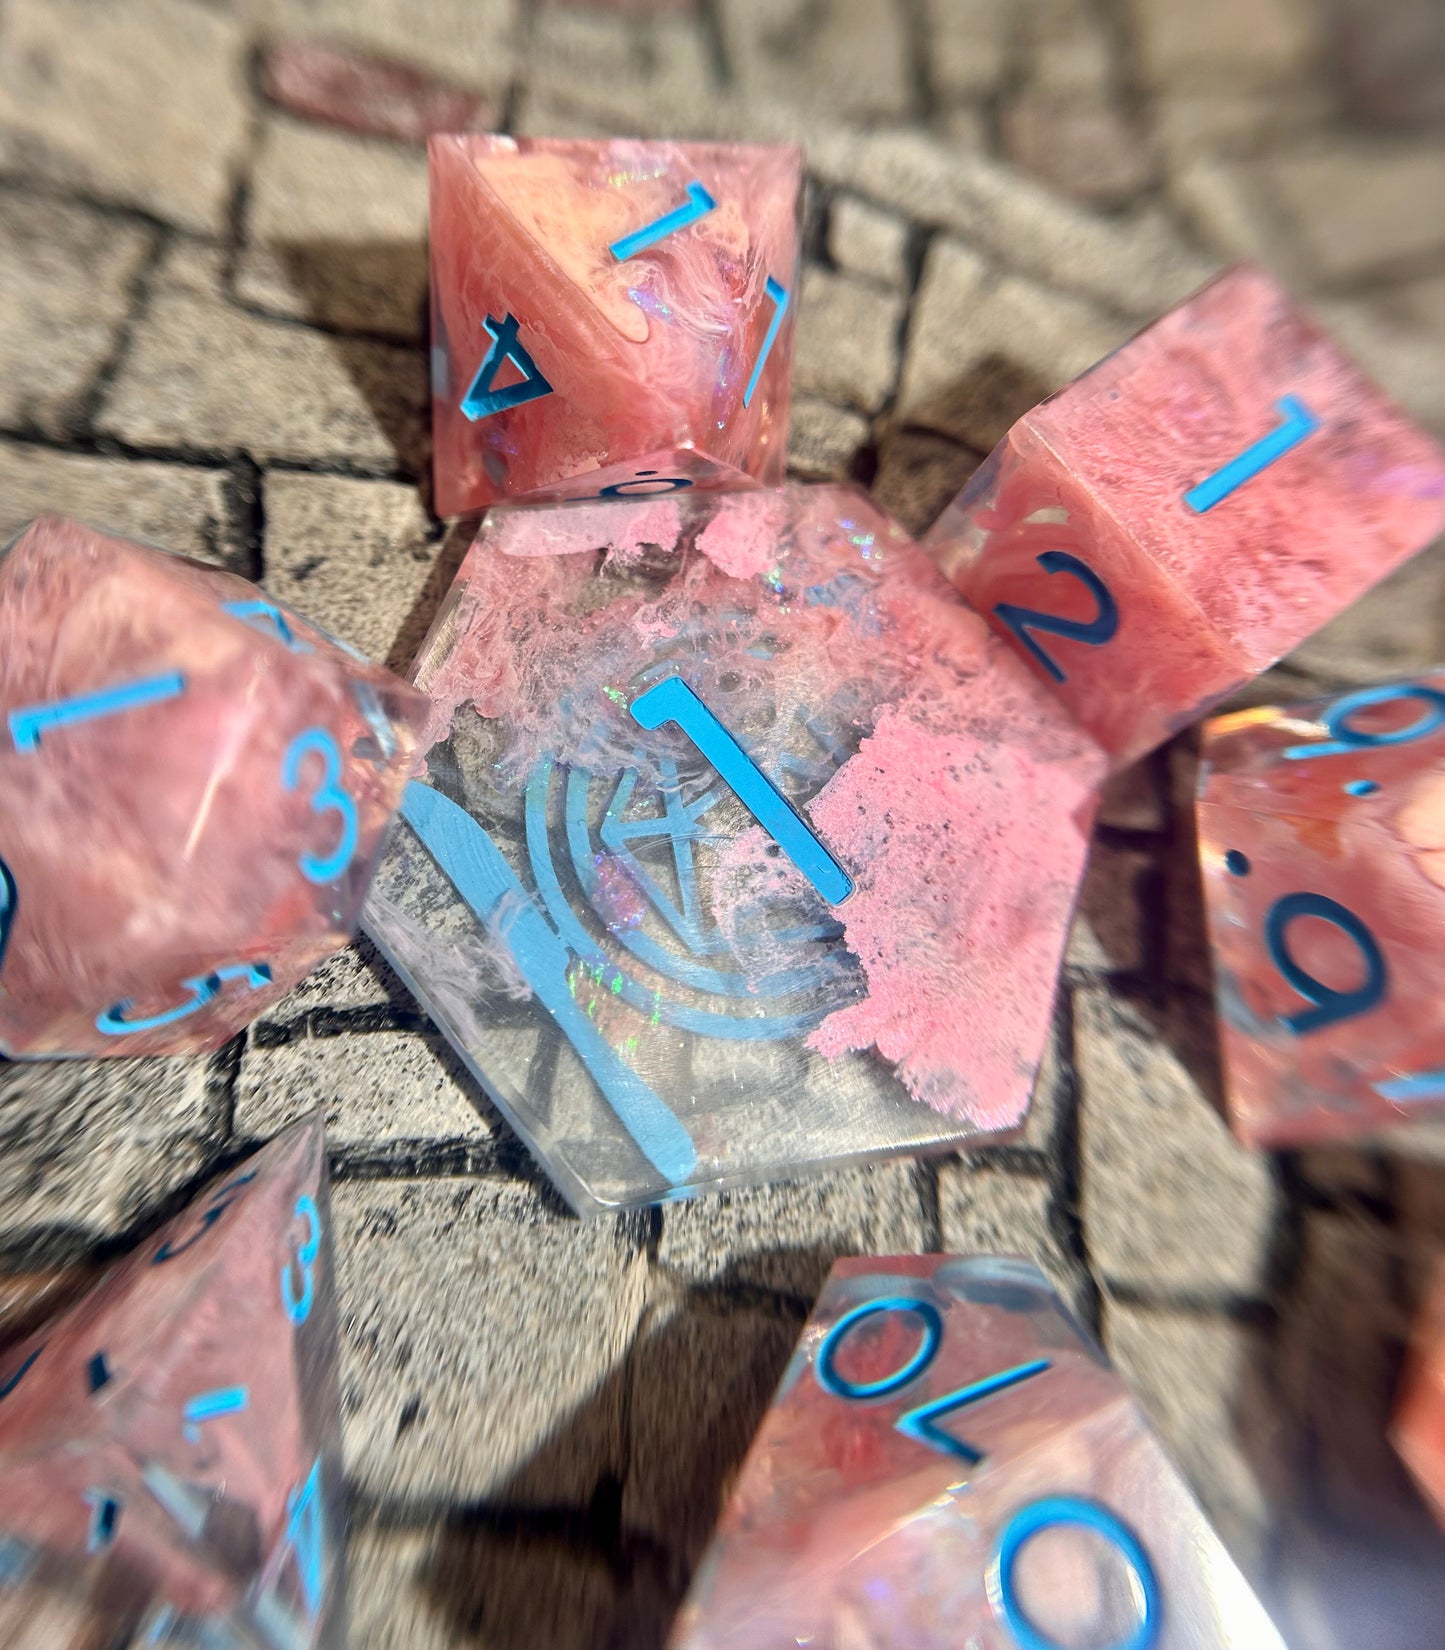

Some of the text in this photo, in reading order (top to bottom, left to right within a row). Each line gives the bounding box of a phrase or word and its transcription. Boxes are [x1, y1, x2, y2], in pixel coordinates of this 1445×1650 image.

[609, 179, 717, 262] 1
[459, 311, 554, 421] 4
[1183, 394, 1322, 513] 1
[992, 551, 1118, 684] 2
[7, 671, 187, 754] 1
[281, 726, 359, 884] 3
[629, 675, 858, 906] 1
